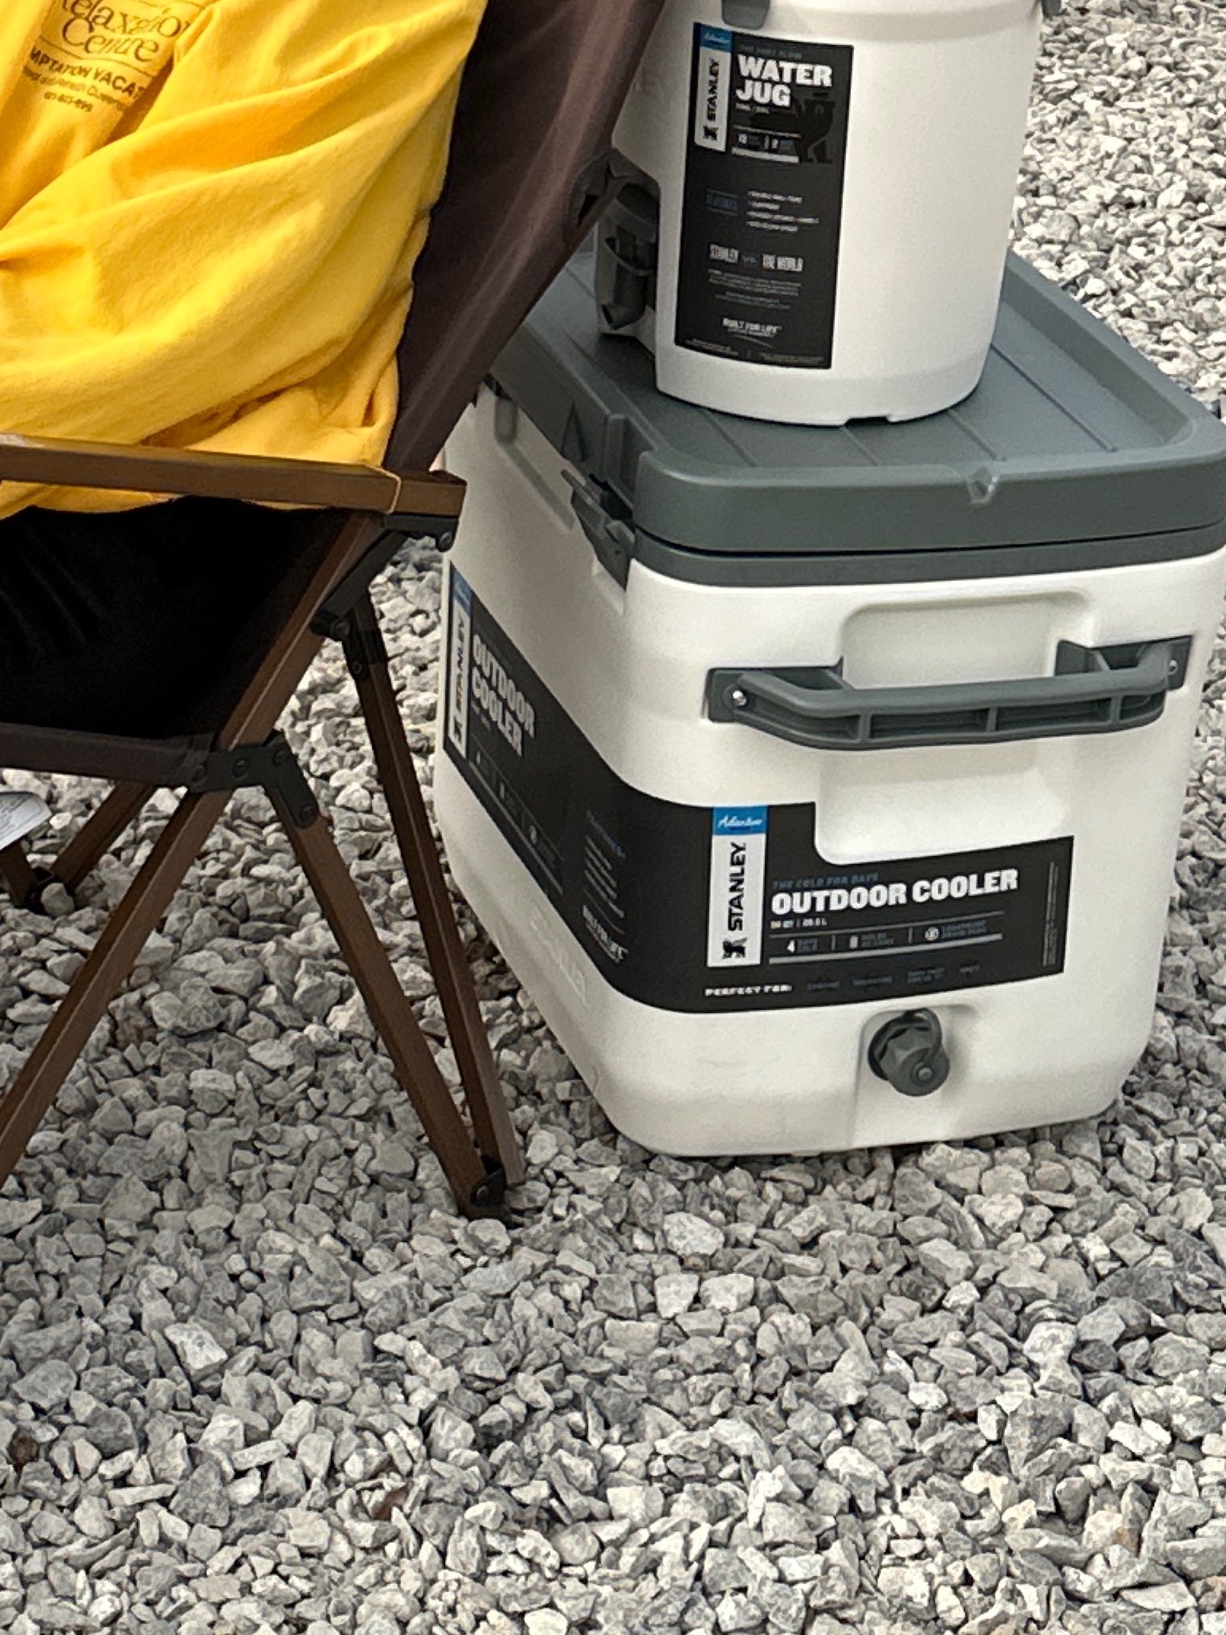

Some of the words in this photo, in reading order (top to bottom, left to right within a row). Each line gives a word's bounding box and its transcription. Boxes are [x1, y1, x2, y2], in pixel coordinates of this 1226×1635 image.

[706, 58, 719, 122] STANLEY
[735, 79, 791, 108] JUG
[737, 53, 833, 87] WATER
[472, 665, 522, 757] COOLER
[473, 633, 535, 738] OUTDOOR
[727, 841, 747, 932] STANLEY
[771, 883, 907, 915] OUTDOOR
[912, 868, 1019, 902] COOLER
[705, 986, 761, 997] PERFECT
